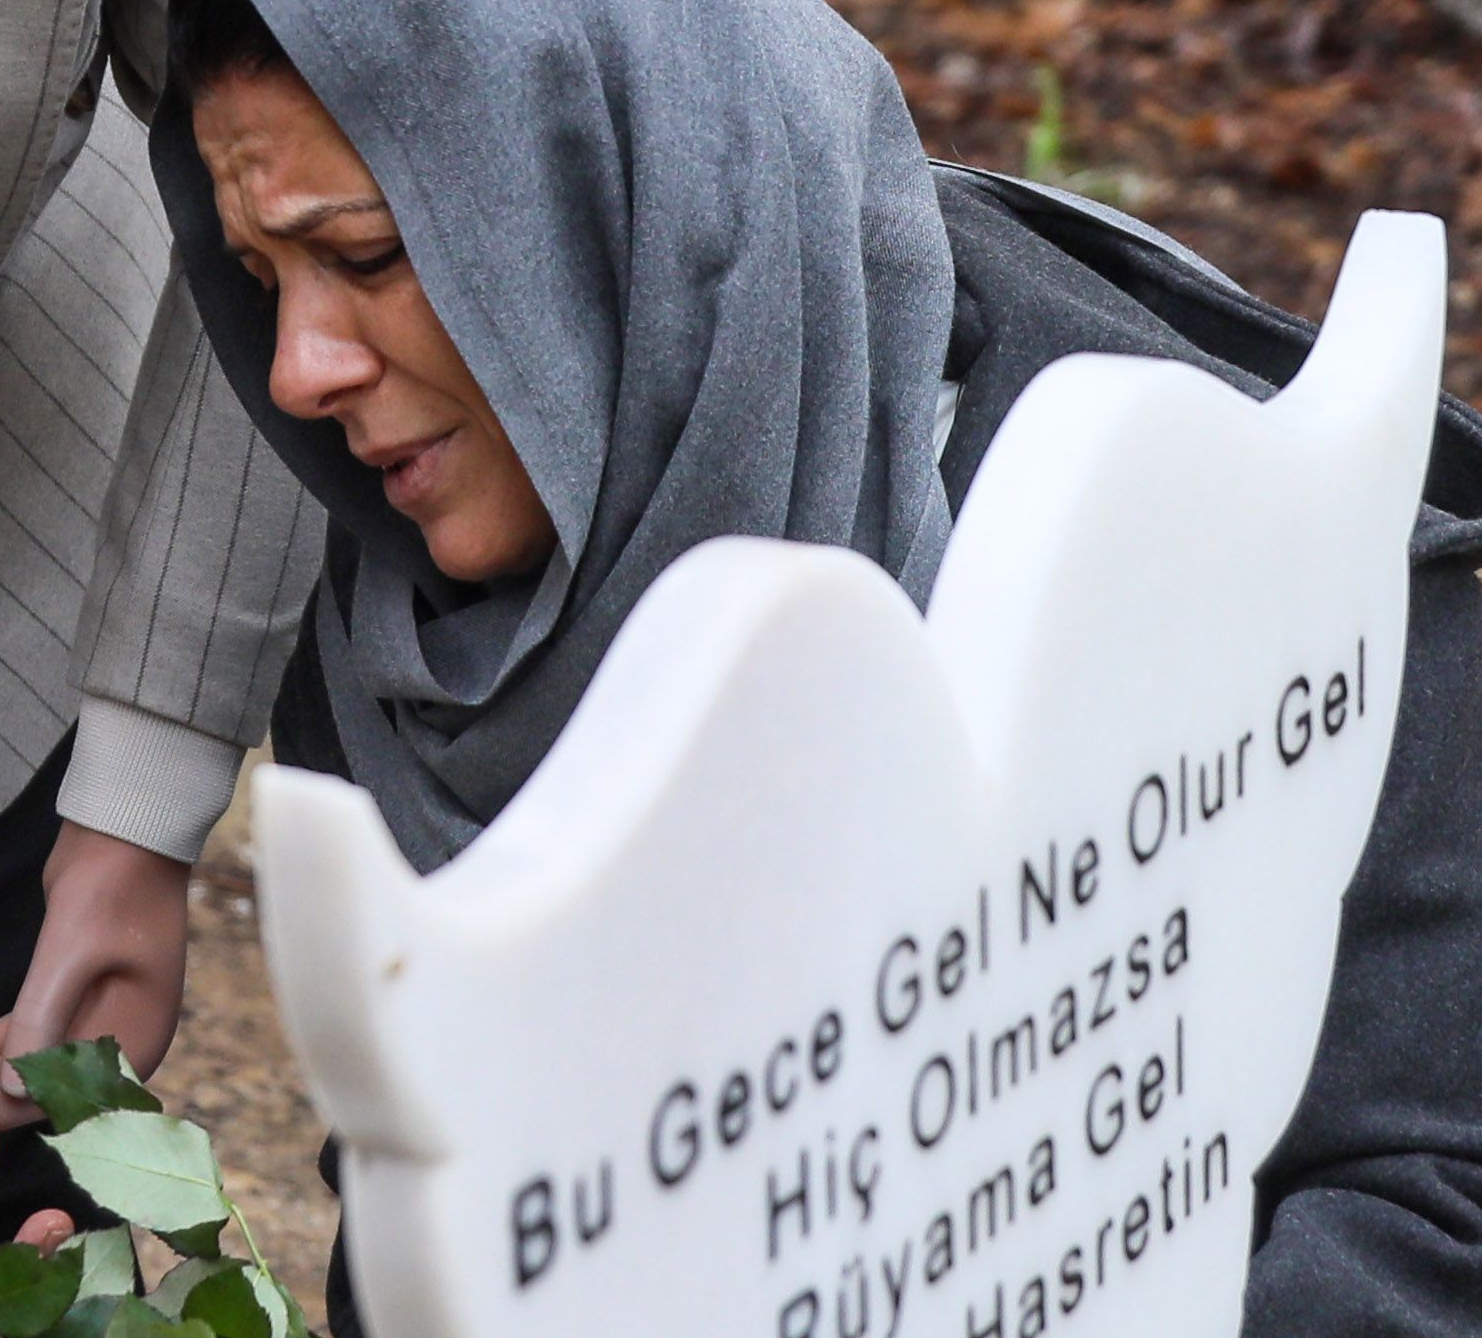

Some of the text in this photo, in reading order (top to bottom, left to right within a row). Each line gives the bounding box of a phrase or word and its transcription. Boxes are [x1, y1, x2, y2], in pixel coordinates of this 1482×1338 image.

[509, 636, 1368, 1292] Bu Gece Gel Ne Olur Gel
[766, 904, 1192, 1260] Hiç Olmazsa
[1083, 1017, 1186, 1160] Gel
